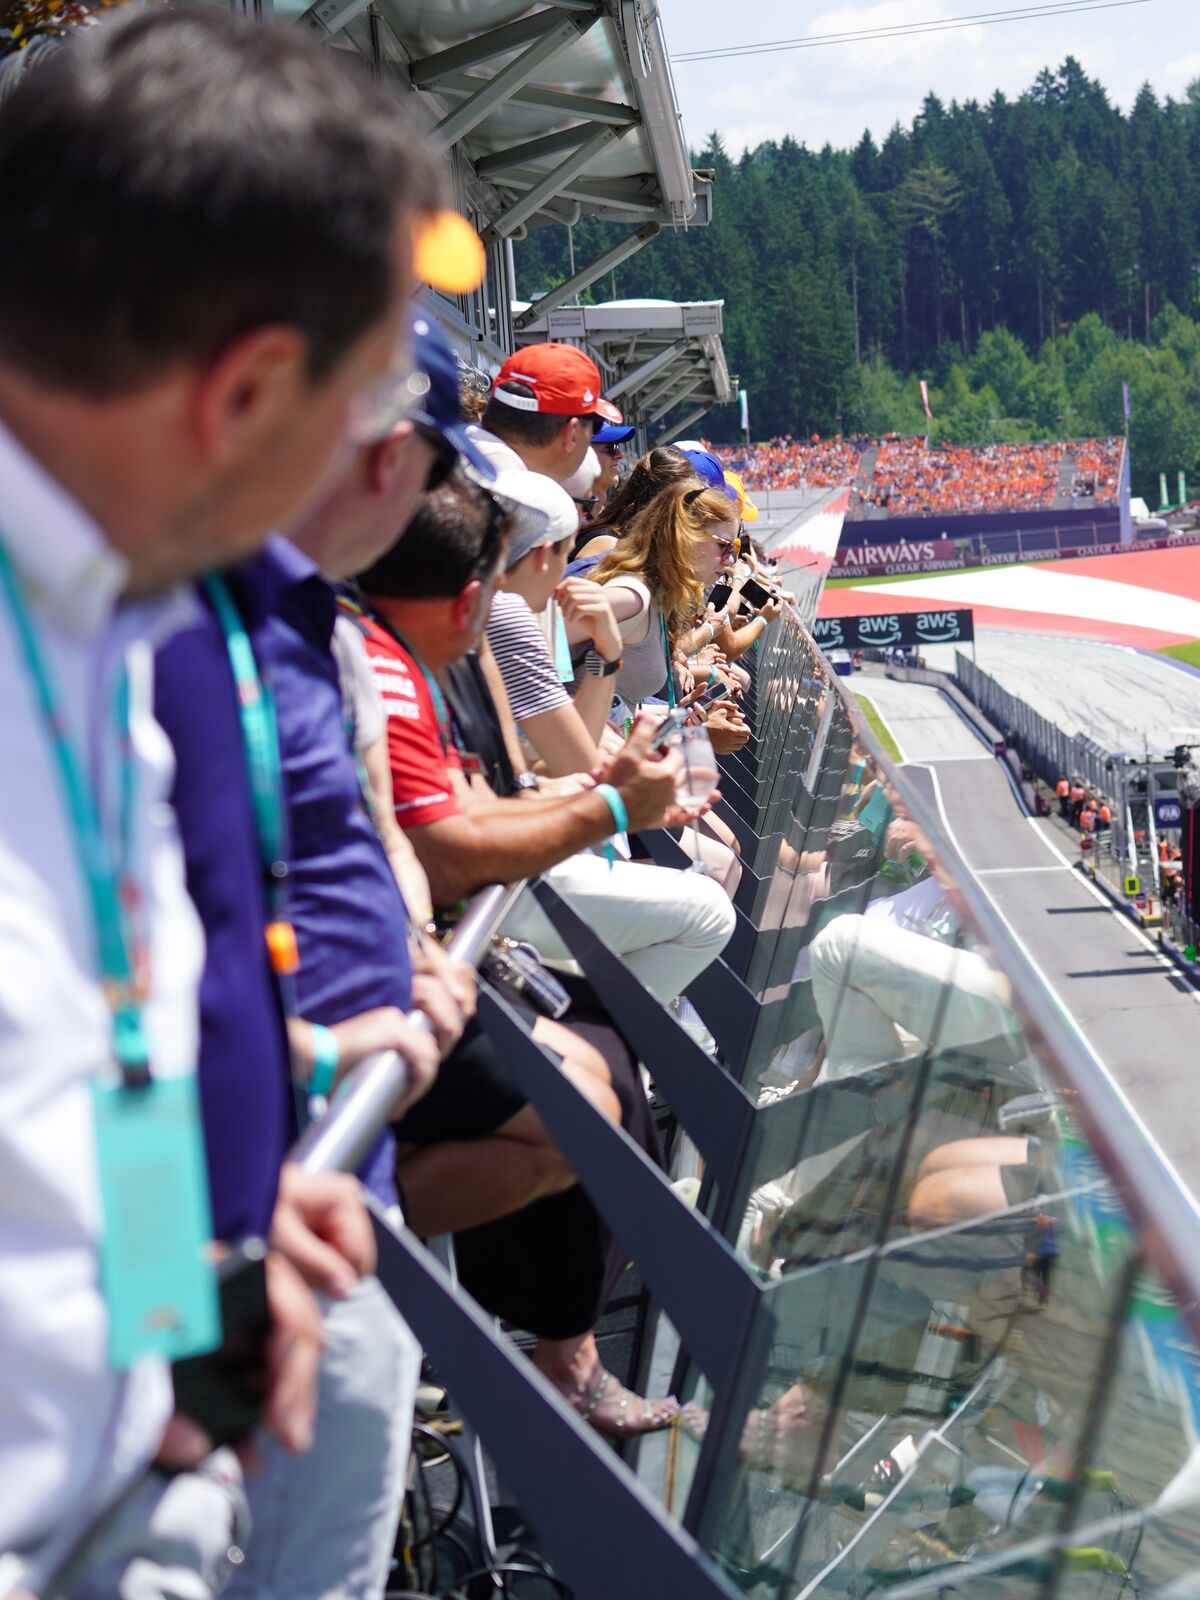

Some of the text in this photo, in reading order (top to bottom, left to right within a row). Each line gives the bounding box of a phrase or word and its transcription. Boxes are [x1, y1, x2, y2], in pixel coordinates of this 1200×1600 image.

[844, 542, 935, 566] AIRWAYS
[981, 553, 1017, 566] QATAR
[885, 558, 965, 575] QATAR AIRWAYS
[813, 612, 958, 636] ws aws aws
[1159, 805, 1180, 820] FIA
